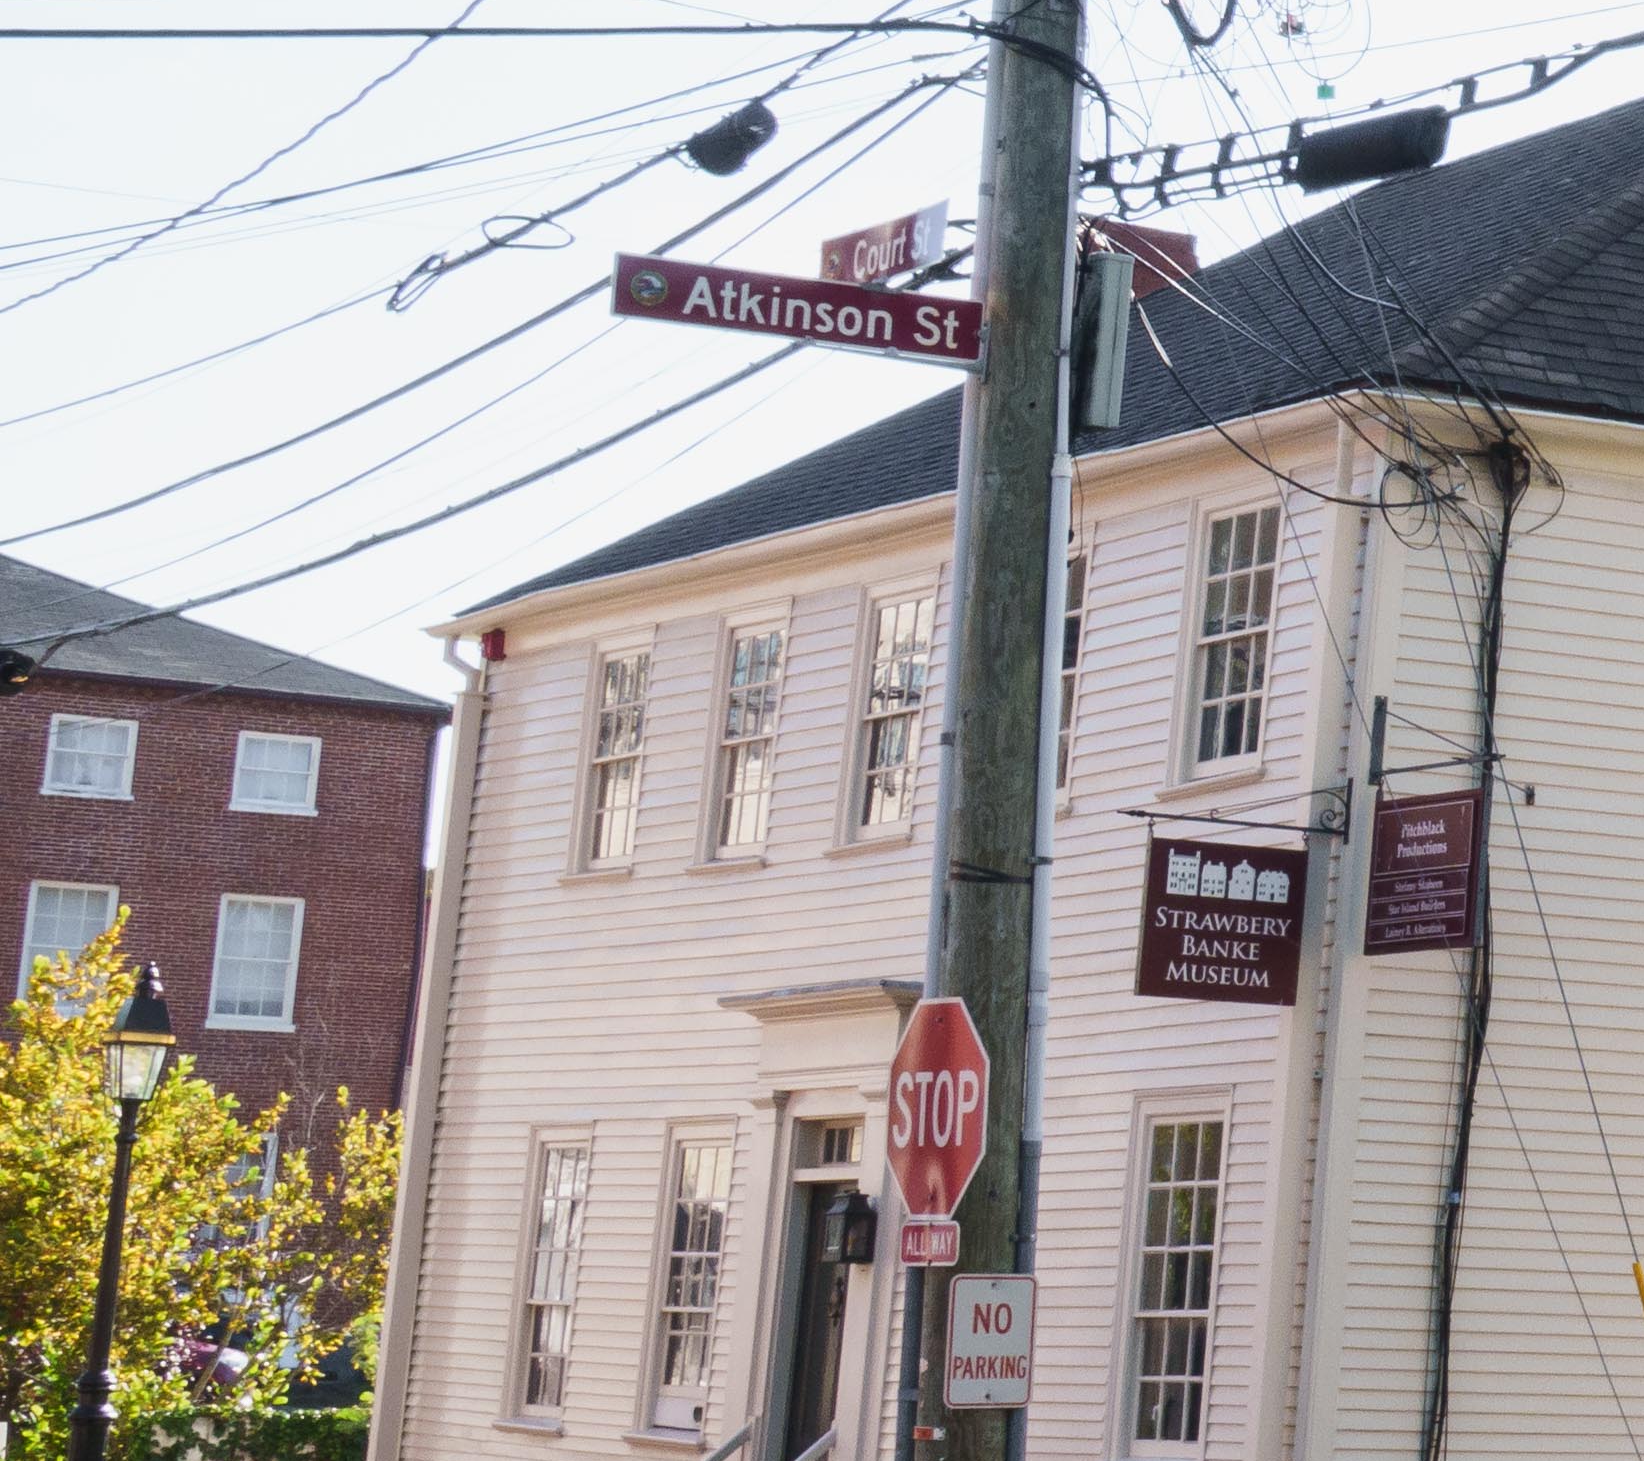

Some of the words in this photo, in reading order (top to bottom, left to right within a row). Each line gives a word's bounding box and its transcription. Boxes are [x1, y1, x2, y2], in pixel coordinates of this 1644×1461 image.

[853, 231, 906, 279] Court
[912, 219, 930, 259] St
[683, 276, 892, 340] Atkinson
[913, 306, 959, 349] St
[1397, 842, 1447, 858] Productions
[1155, 906, 1292, 937] STRAWBERY
[1182, 934, 1260, 961] BANKE
[1165, 961, 1269, 989] MUSEUM
[892, 1070, 980, 1148] STOP
[906, 1233, 928, 1256] ALL
[931, 1232, 953, 1257] WAY
[972, 1302, 1012, 1334] NO
[953, 1354, 1027, 1380] PARKING
